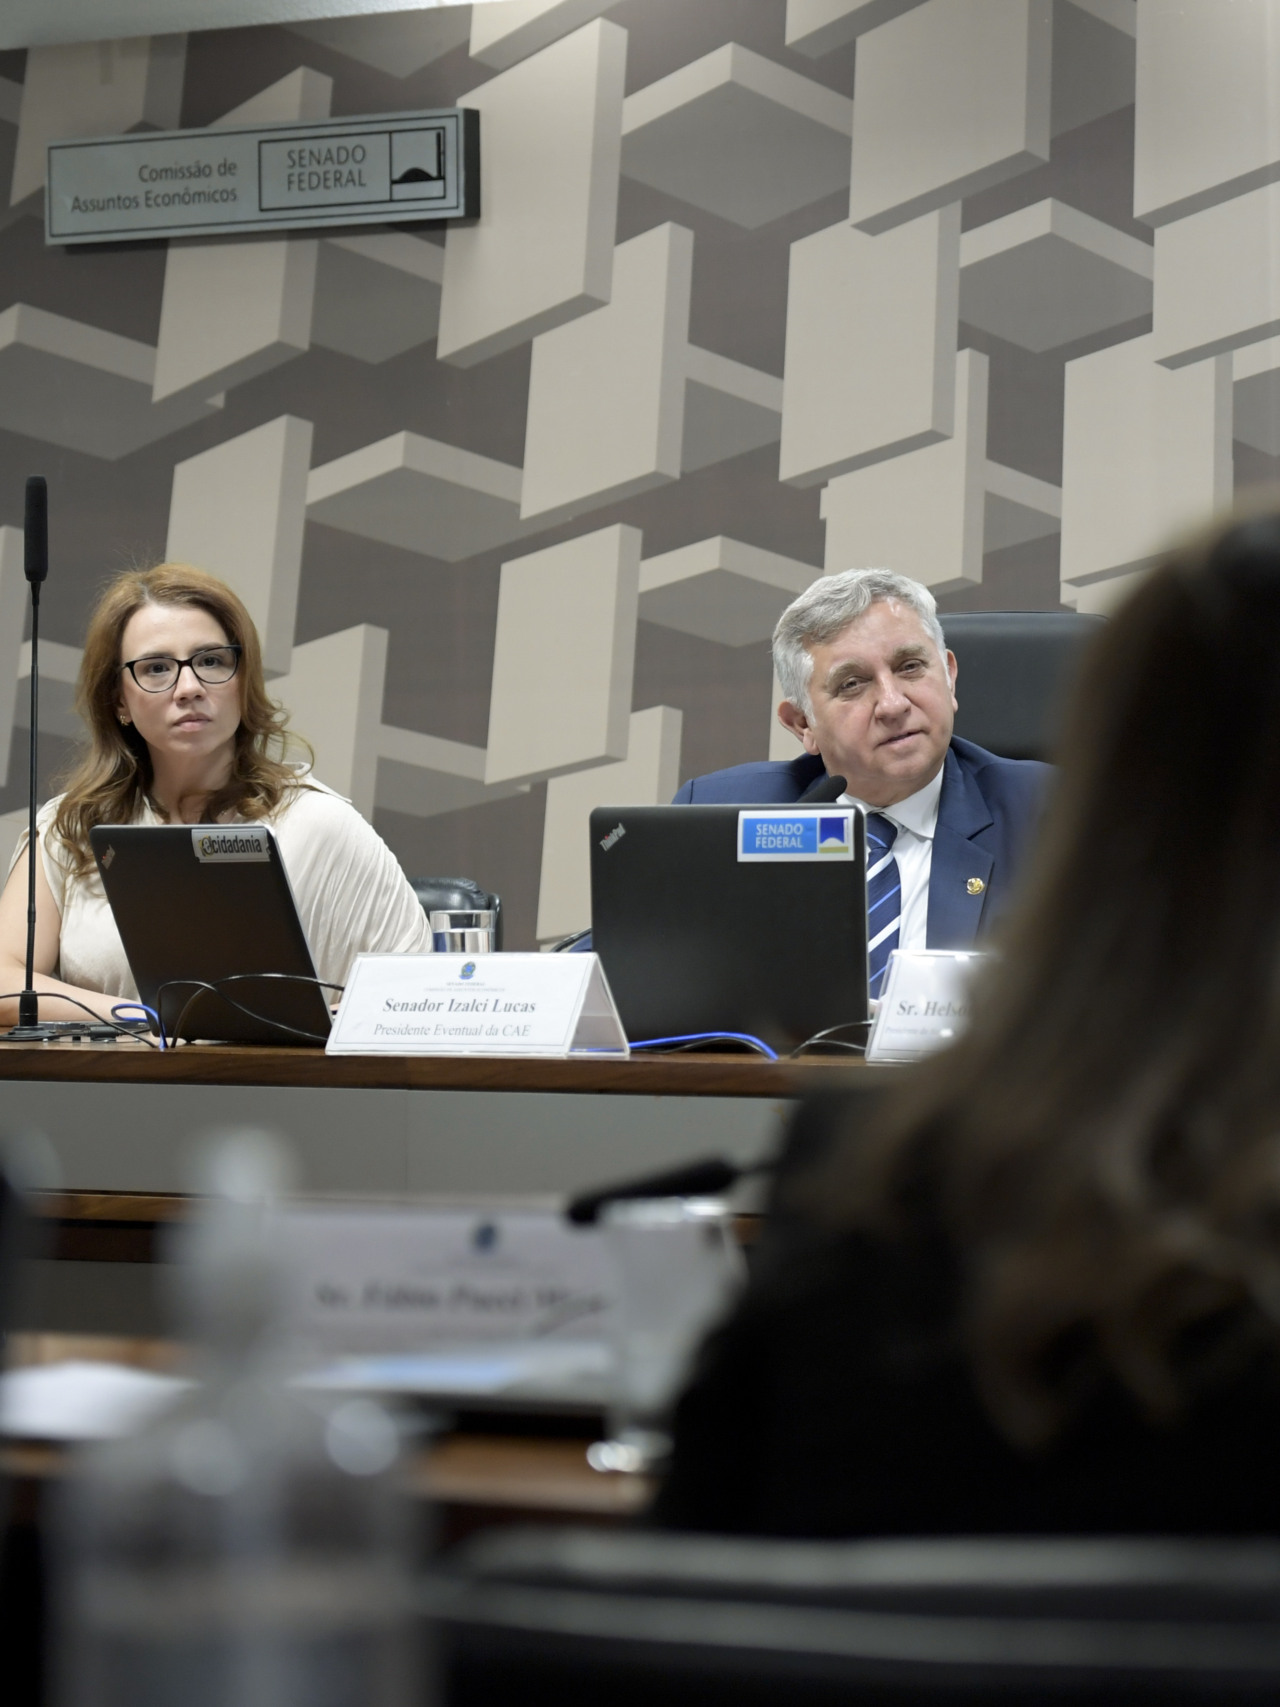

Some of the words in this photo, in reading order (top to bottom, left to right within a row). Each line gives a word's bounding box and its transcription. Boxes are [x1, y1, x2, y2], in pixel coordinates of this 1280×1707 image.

[286, 144, 367, 169] SENADO
[138, 160, 213, 183] Comissão
[216, 158, 238, 177] de
[286, 169, 367, 192] FEDERAL
[70, 194, 140, 214] Assuntos
[144, 184, 238, 209] Econômicos
[755, 823, 804, 836] SENADO
[755, 837, 804, 849] FEDERAL
[382, 998, 444, 1014] Senador
[447, 998, 488, 1014] Izalci
[492, 999, 536, 1014] Lucas
[896, 1001, 918, 1017] Sr.
[923, 1001, 968, 1017] Helso
[374, 1023, 431, 1036] Presidente
[433, 1024, 484, 1037] Eventual
[485, 1024, 499, 1037] da
[502, 1025, 532, 1037] CAE
